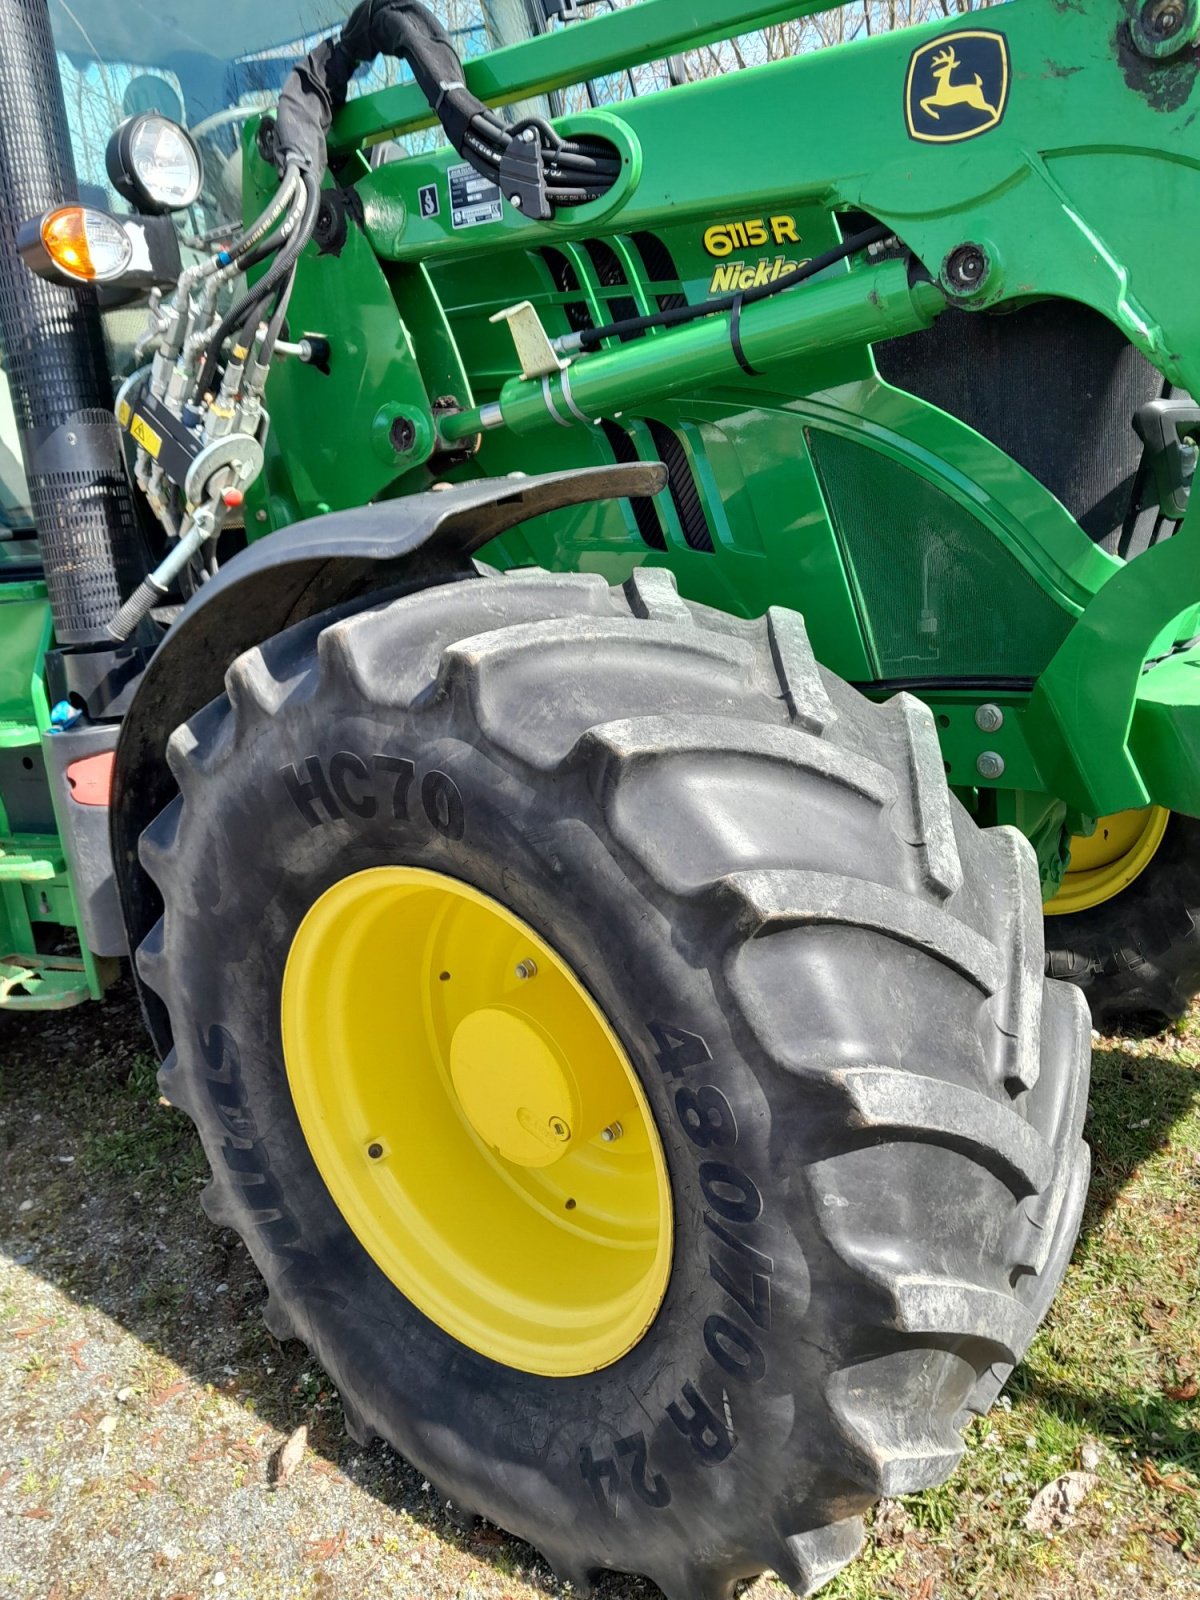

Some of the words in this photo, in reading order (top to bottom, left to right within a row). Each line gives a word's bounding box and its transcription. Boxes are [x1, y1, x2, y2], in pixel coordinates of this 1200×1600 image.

[702, 218, 769, 257] 6115
[770, 215, 801, 245] R
[709, 255, 812, 294] Nickla
[280, 750, 465, 841] HC70
[579, 1430, 673, 1518] 24
